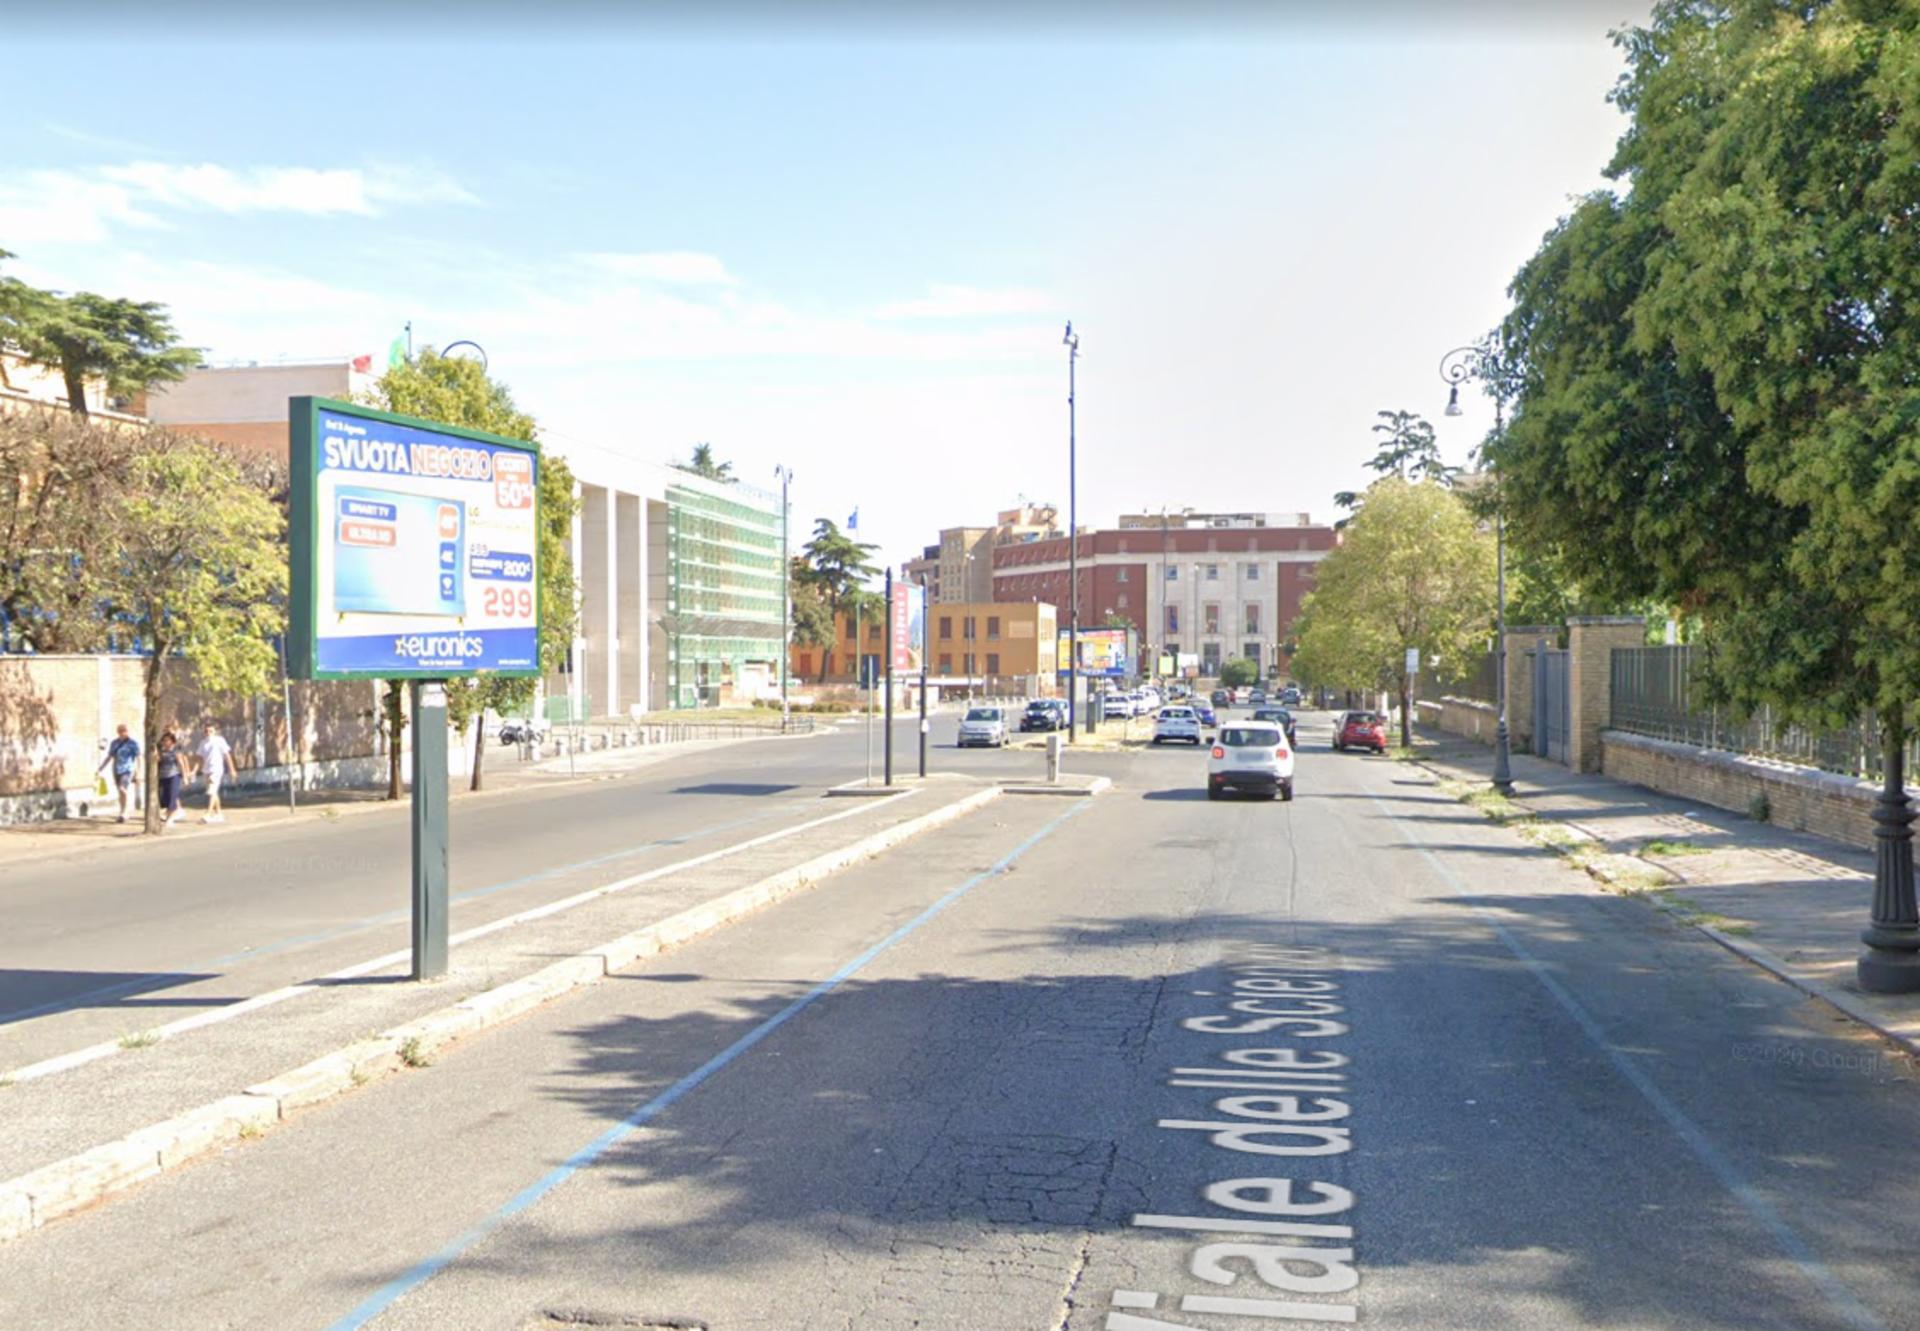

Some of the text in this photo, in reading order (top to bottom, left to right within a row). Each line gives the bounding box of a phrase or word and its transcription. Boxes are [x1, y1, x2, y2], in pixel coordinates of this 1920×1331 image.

[324, 436, 491, 481] SVUOTA NEGOZIO
[483, 586, 532, 619] 299
[407, 631, 483, 657] euronics
